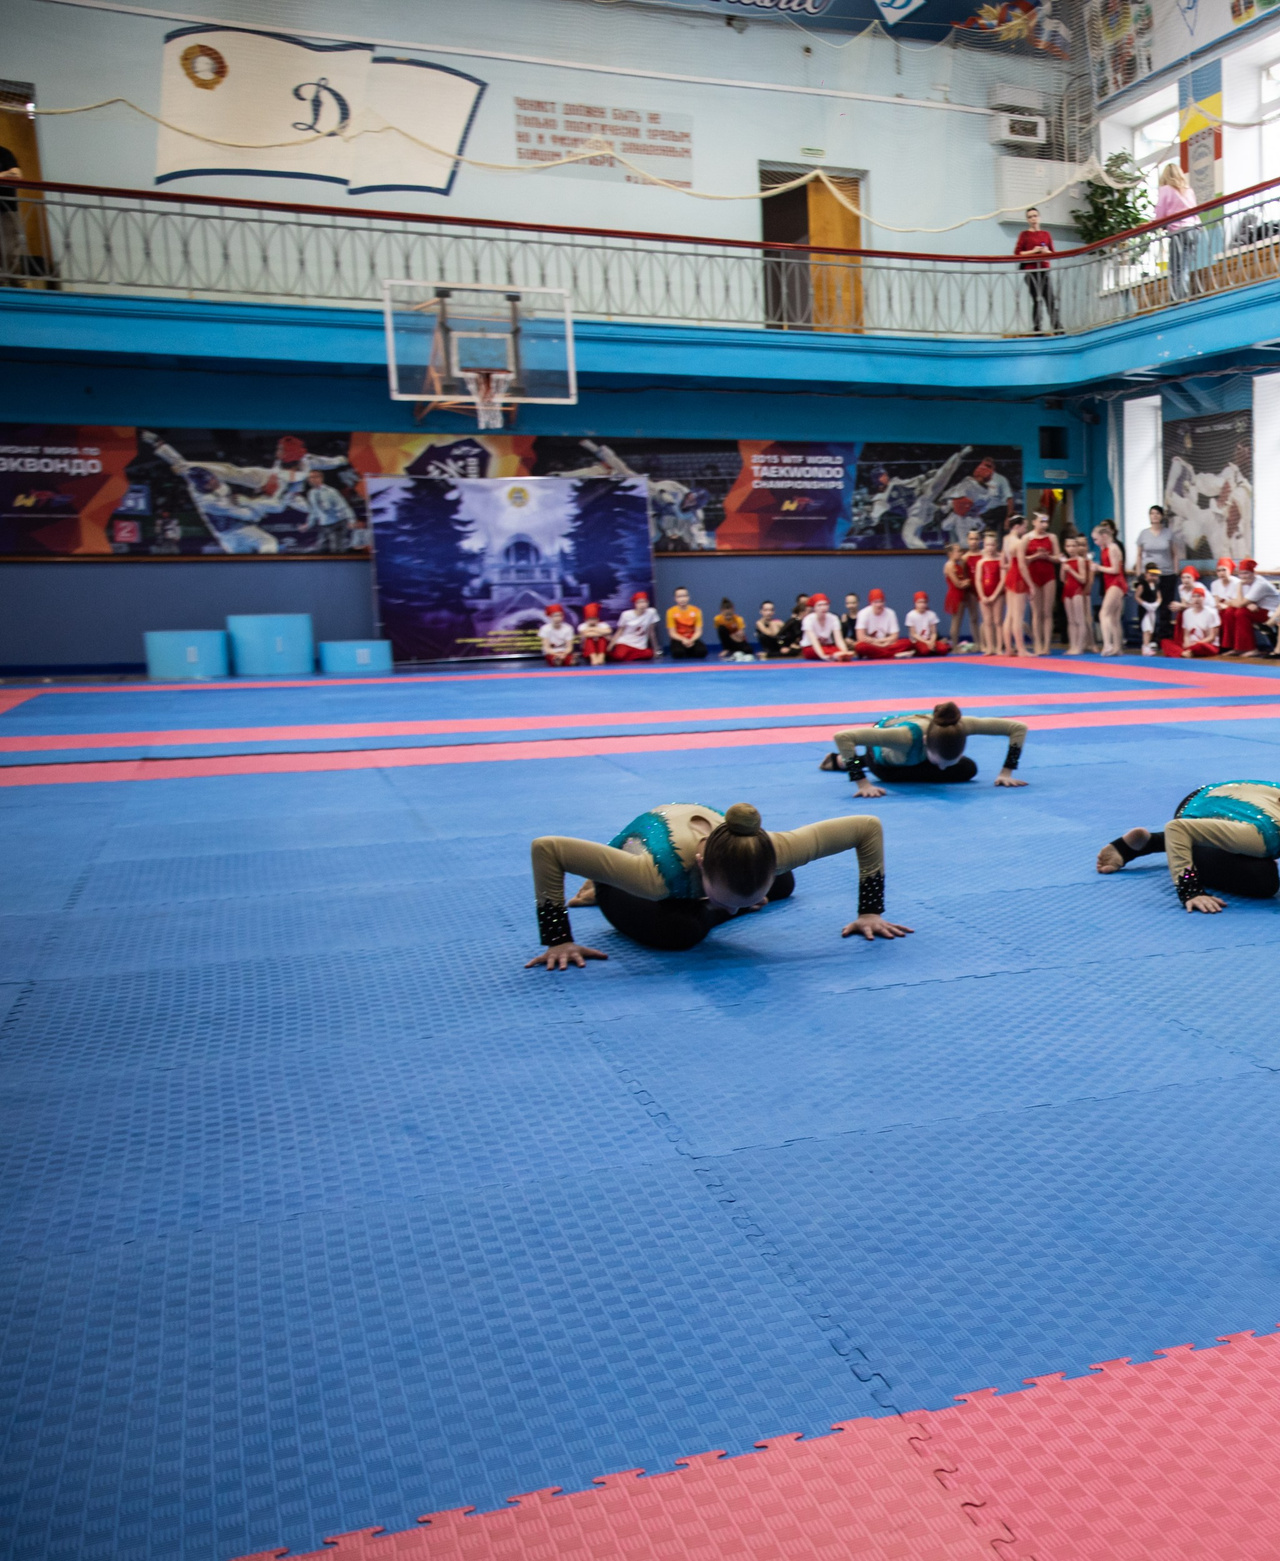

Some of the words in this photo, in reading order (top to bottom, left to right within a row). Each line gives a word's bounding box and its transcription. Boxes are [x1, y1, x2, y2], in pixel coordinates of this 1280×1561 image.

[751, 454, 779, 464] 2015
[781, 455, 804, 464] WTF
[805, 456, 844, 465] WORLD
[751, 465, 844, 478] TAEKWONDO
[751, 480, 844, 489] CHAMPIONSHIPS
